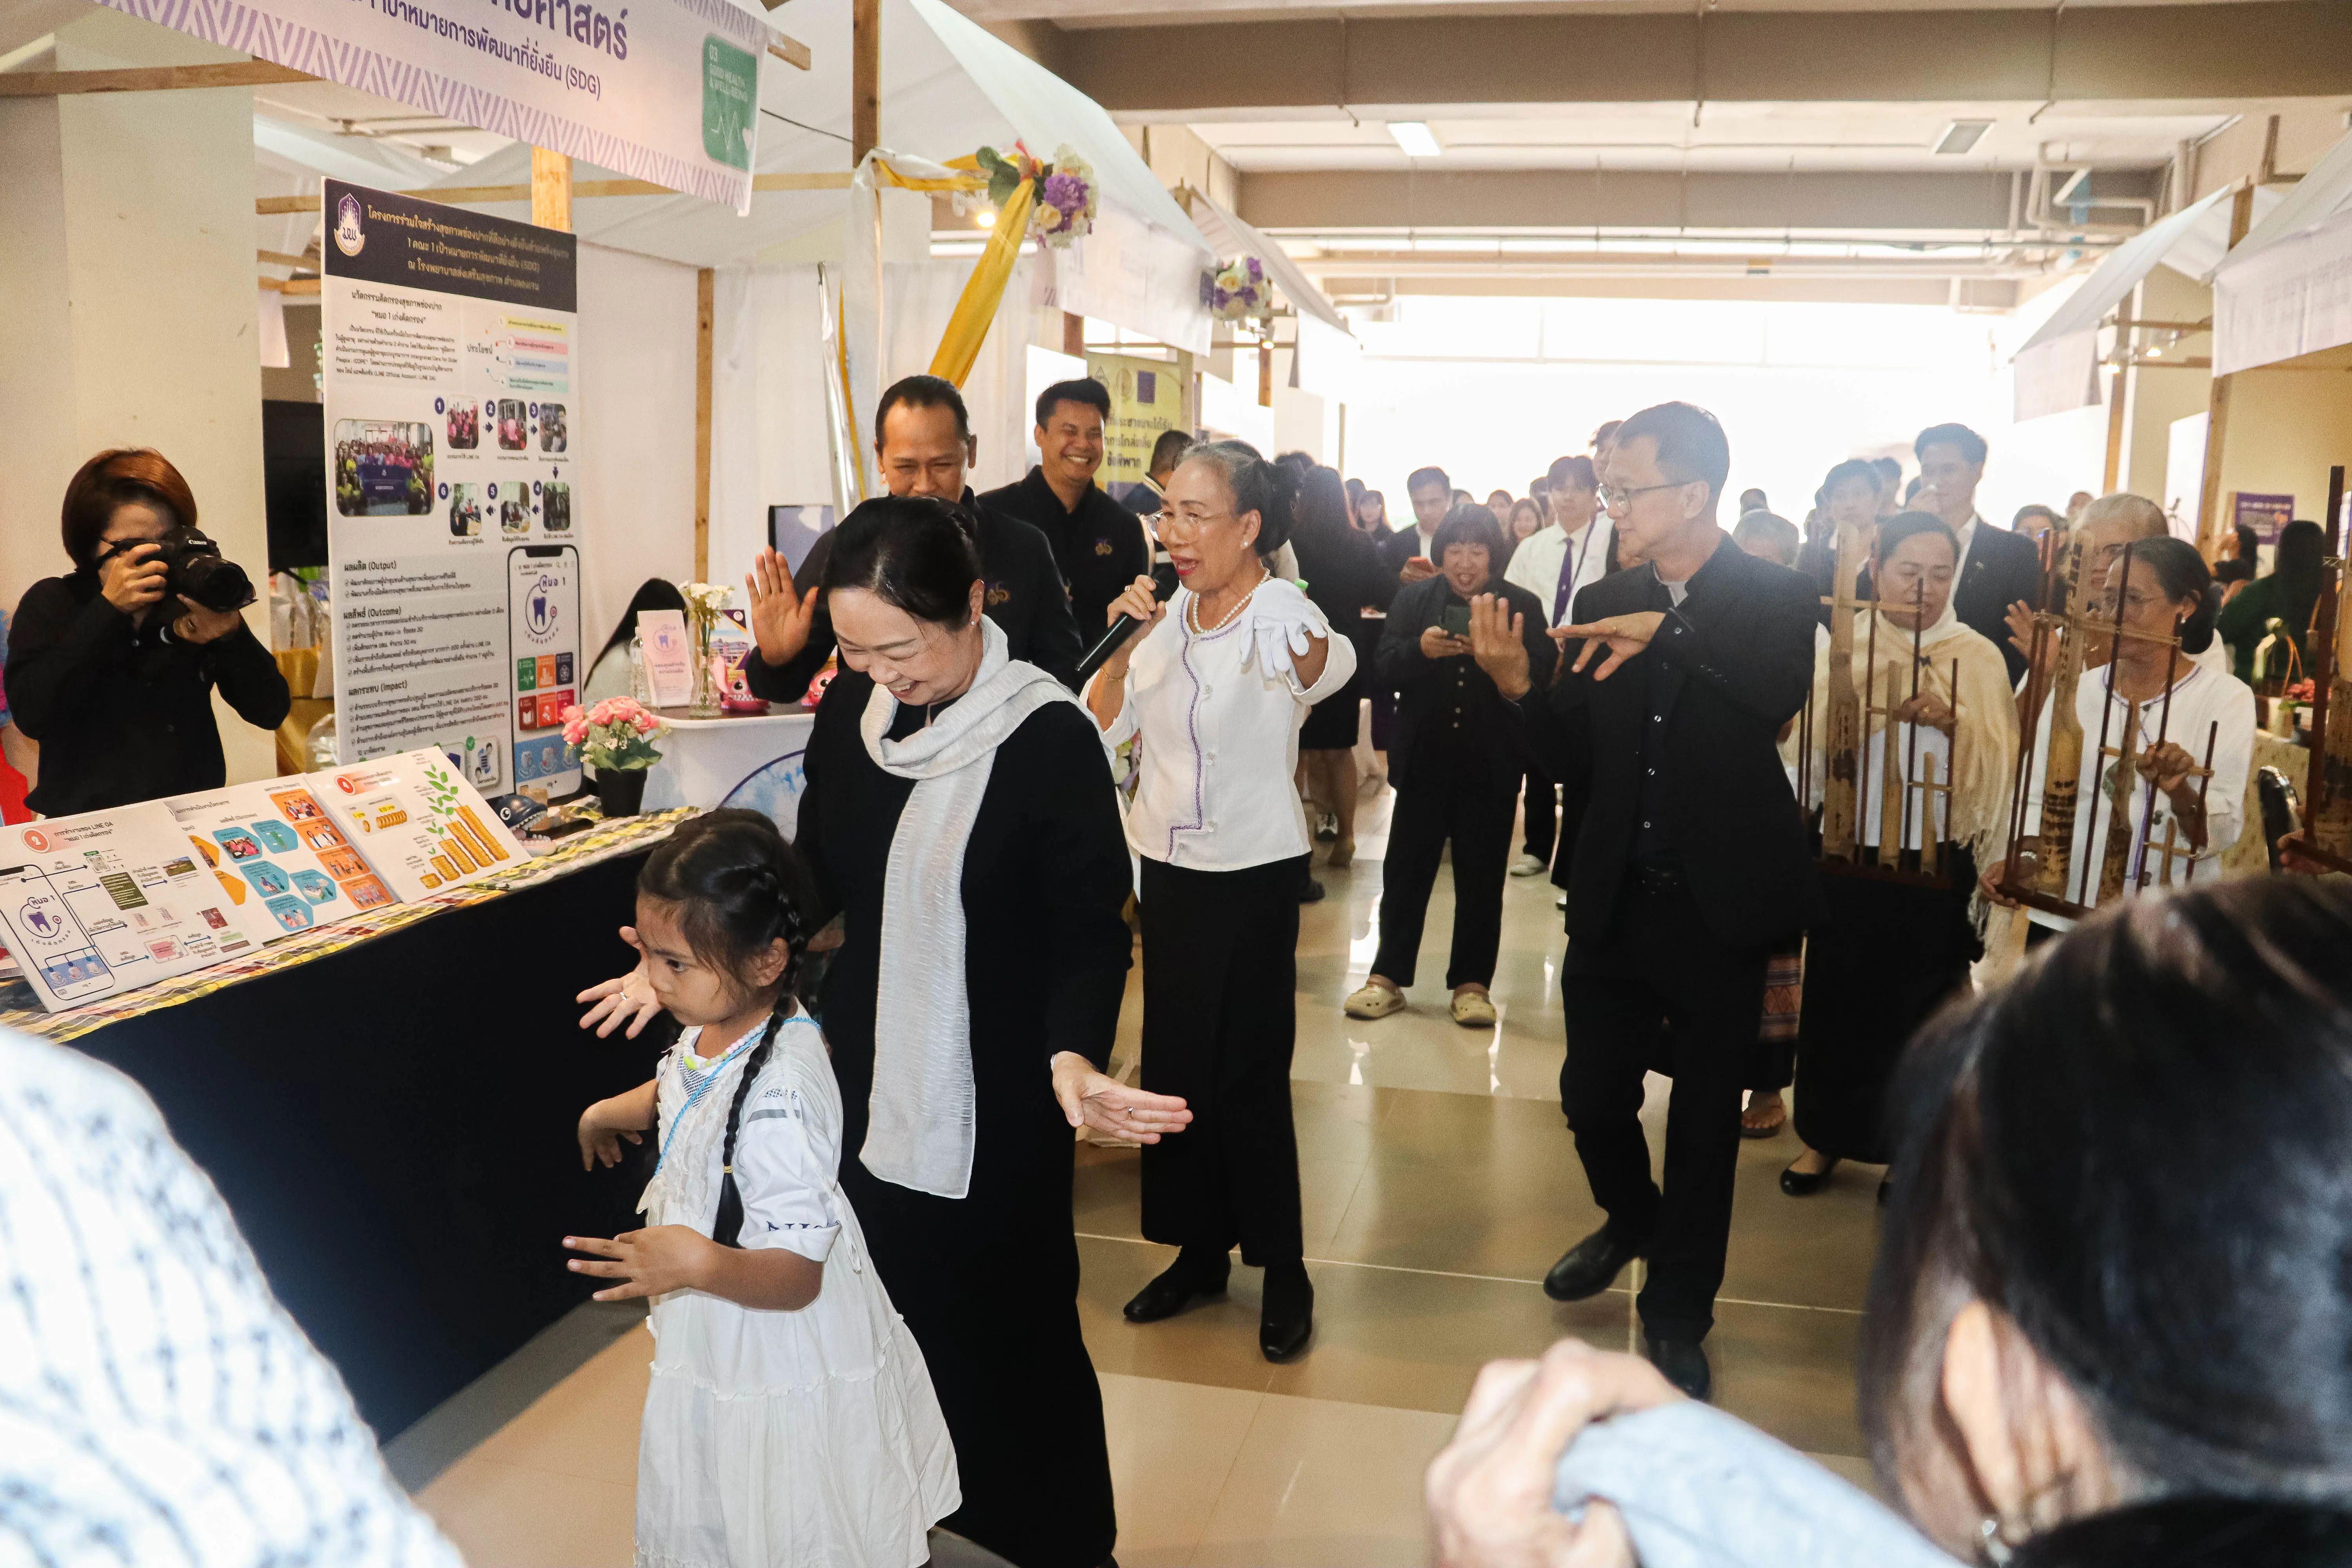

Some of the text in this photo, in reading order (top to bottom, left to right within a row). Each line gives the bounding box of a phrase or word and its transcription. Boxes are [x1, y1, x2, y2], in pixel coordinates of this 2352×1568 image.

[566, 64, 601, 101] (SDG)
[437, 401, 442, 411] 1
[488, 405, 493, 414] 2
[532, 405, 536, 414] 3
[441, 486, 446, 496] 6
[490, 486, 495, 496] 5
[368, 560, 396, 571] (Output)
[368, 606, 401, 618] (Outcome)
[54, 826, 91, 837] การทำงานของ
[31, 836, 42, 846] 2
[31, 897, 49, 905] หมอ
